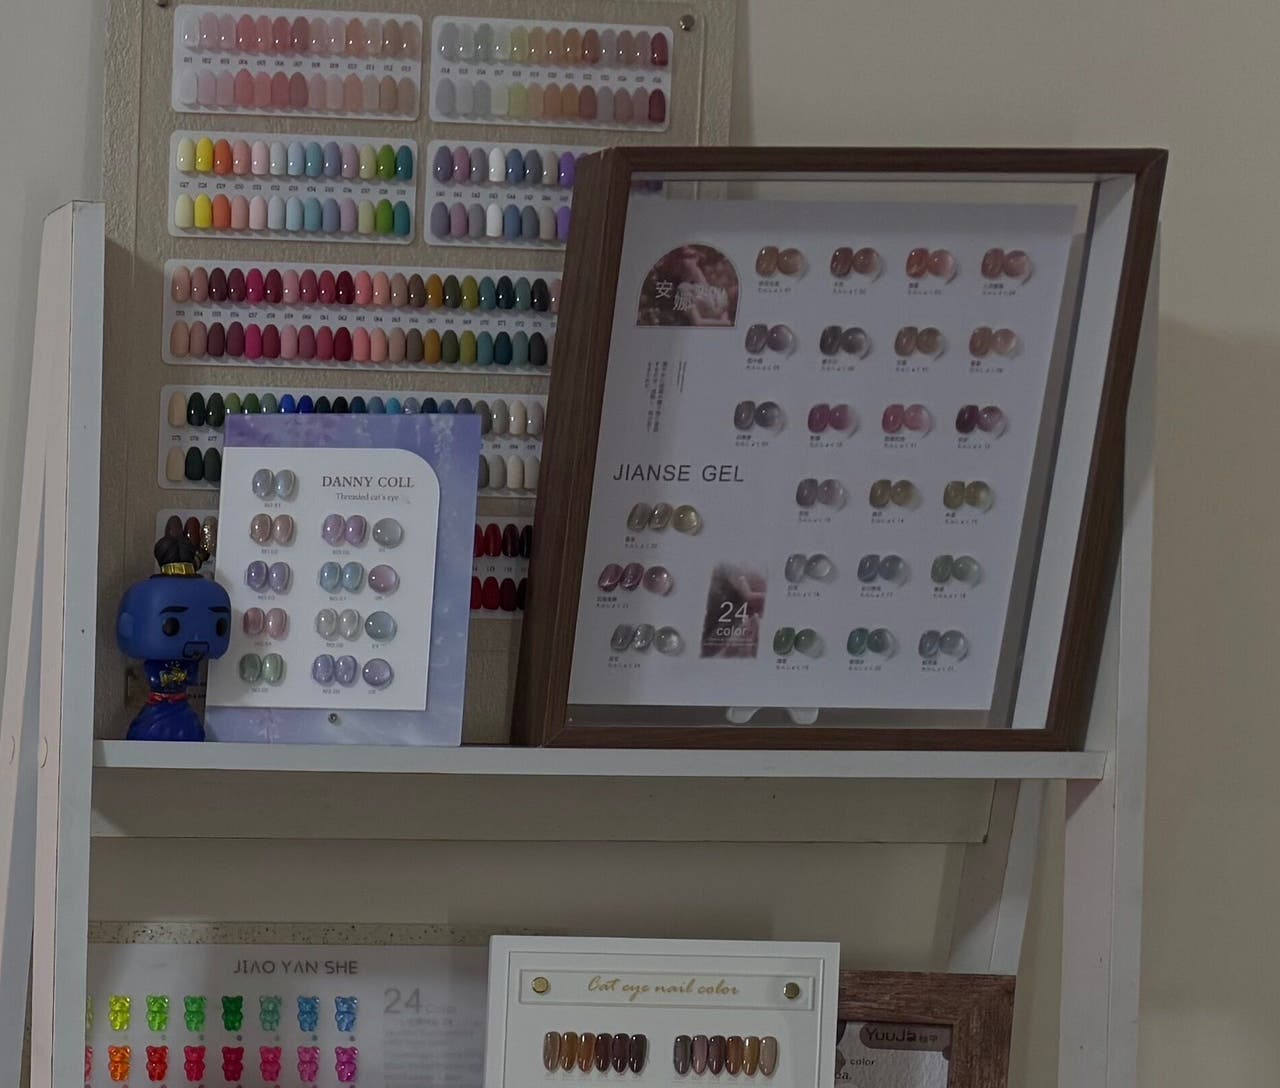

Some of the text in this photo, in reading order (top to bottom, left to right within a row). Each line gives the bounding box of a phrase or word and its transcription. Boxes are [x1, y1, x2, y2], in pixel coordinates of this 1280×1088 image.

[322, 475, 373, 488] DANNY
[613, 463, 745, 482] JIANSE GEL
[718, 601, 749, 623] 24
[716, 625, 748, 637] color
[233, 960, 359, 975] JIAO YAN SHE
[654, 978, 696, 994] nail
[697, 978, 740, 996] color
[383, 987, 424, 1015] 24
